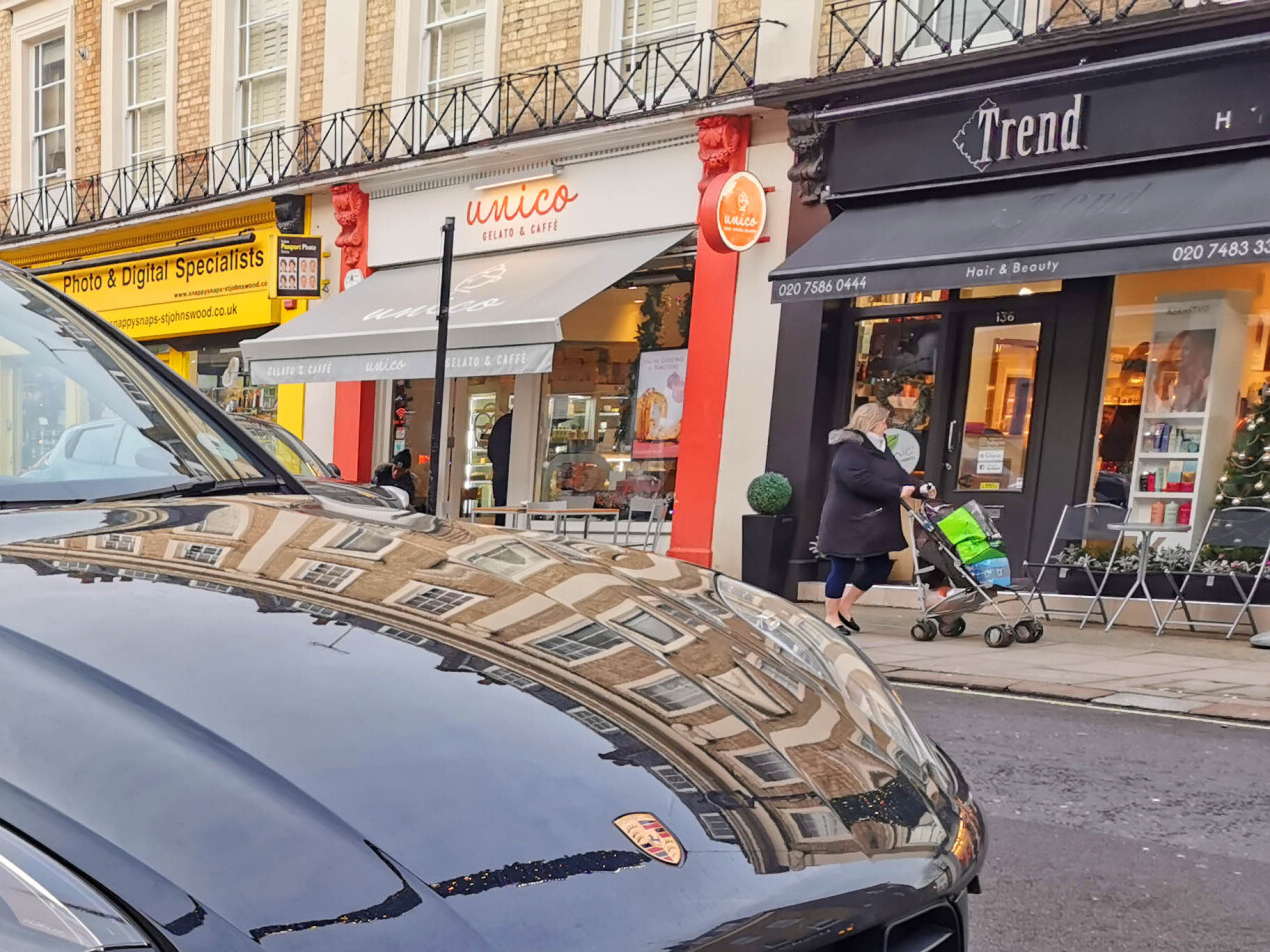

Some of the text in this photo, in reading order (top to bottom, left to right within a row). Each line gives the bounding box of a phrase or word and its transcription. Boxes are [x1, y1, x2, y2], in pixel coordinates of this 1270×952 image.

[977, 93, 1083, 163] Trend
[466, 184, 579, 226] unico
[724, 213, 758, 228] unico
[482, 228, 514, 241] GELATO
[519, 226, 526, 236] &
[301, 243, 317, 251] Photo
[1172, 244, 1204, 261] 020
[1206, 240, 1249, 259] 7483
[63, 247, 265, 294] Photo & Digital Specialists
[965, 259, 1060, 278] Hair & Beauty
[778, 276, 867, 297] 020 7586 0444
[996, 311, 1015, 323] 136
[365, 358, 406, 373] unico
